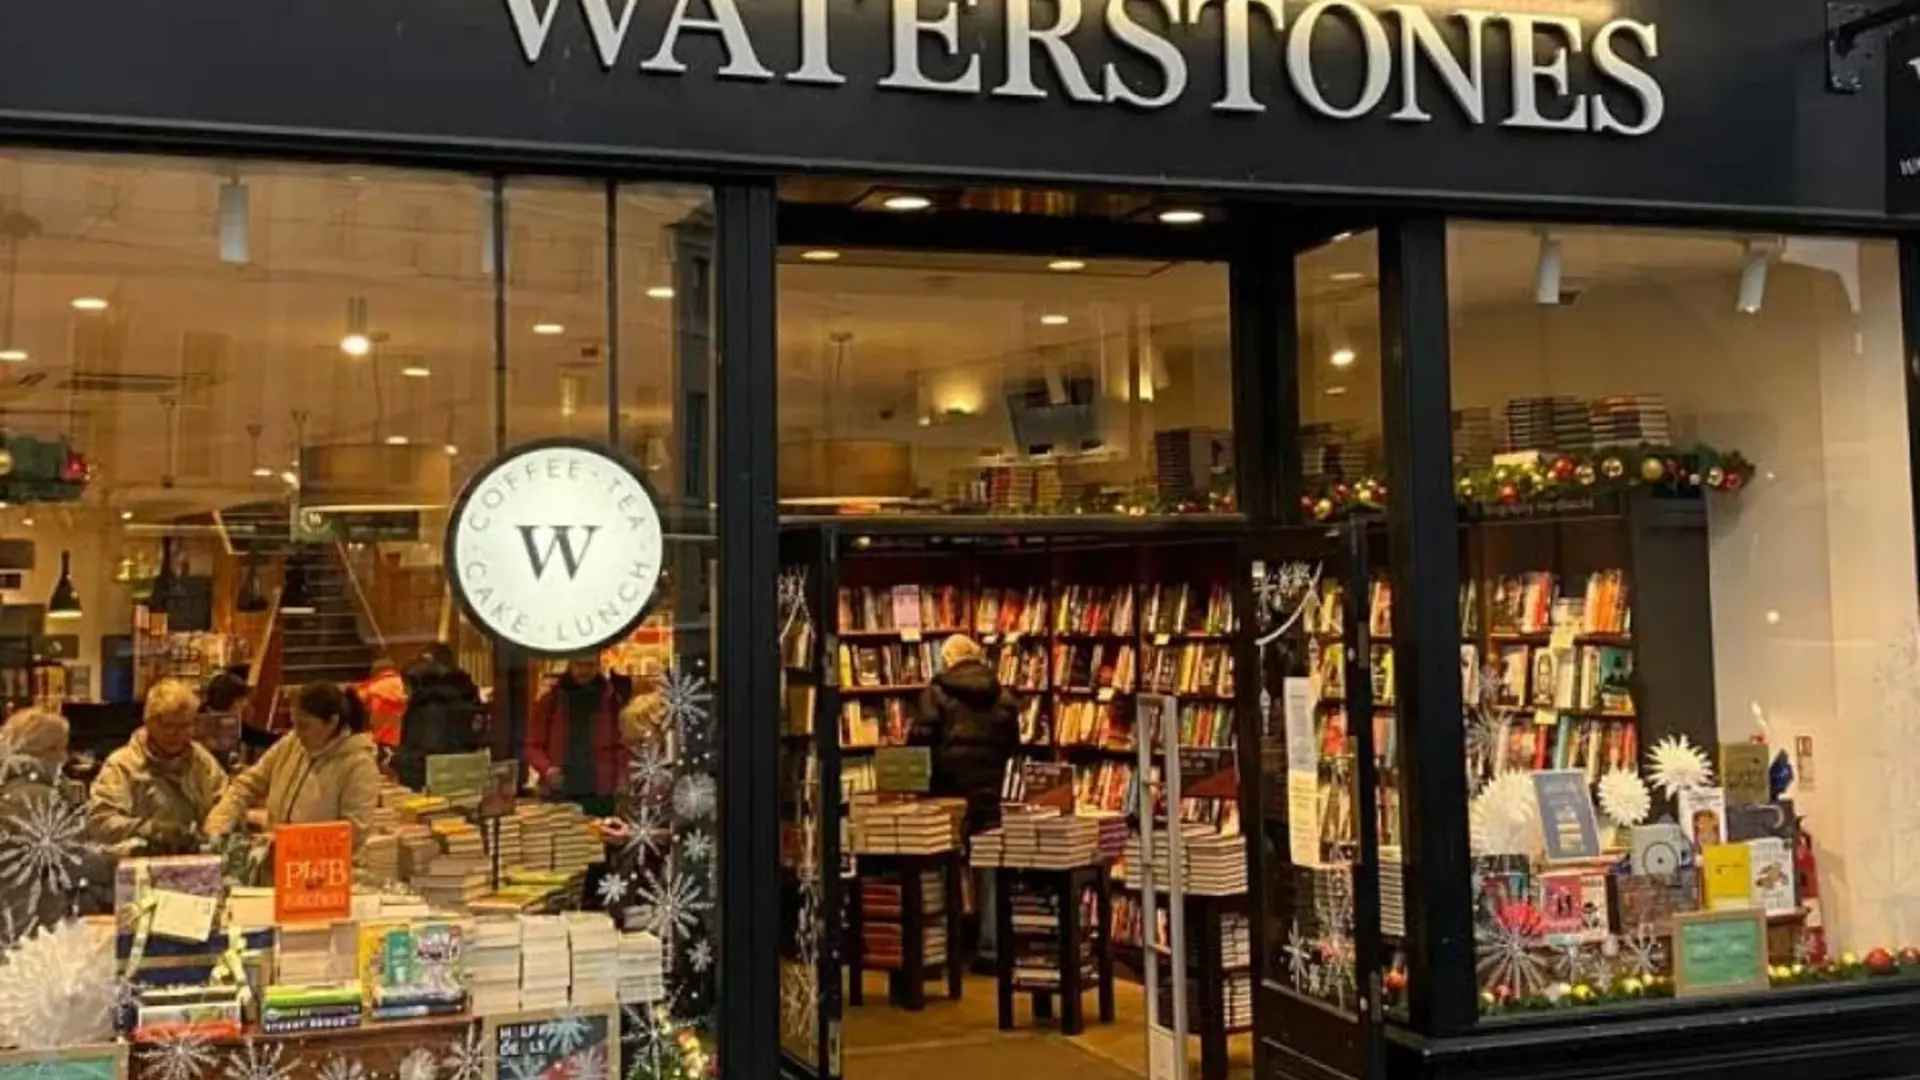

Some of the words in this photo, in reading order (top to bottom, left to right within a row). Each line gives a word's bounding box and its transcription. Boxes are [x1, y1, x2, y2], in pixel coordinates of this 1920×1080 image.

[507, 0, 1665, 136] WATERSTONES
[469, 458, 581, 532] COFFEE
[606, 478, 646, 531] TEA
[514, 525, 601, 581] W
[466, 561, 529, 634] CAKE
[557, 562, 651, 641] LUNCH
